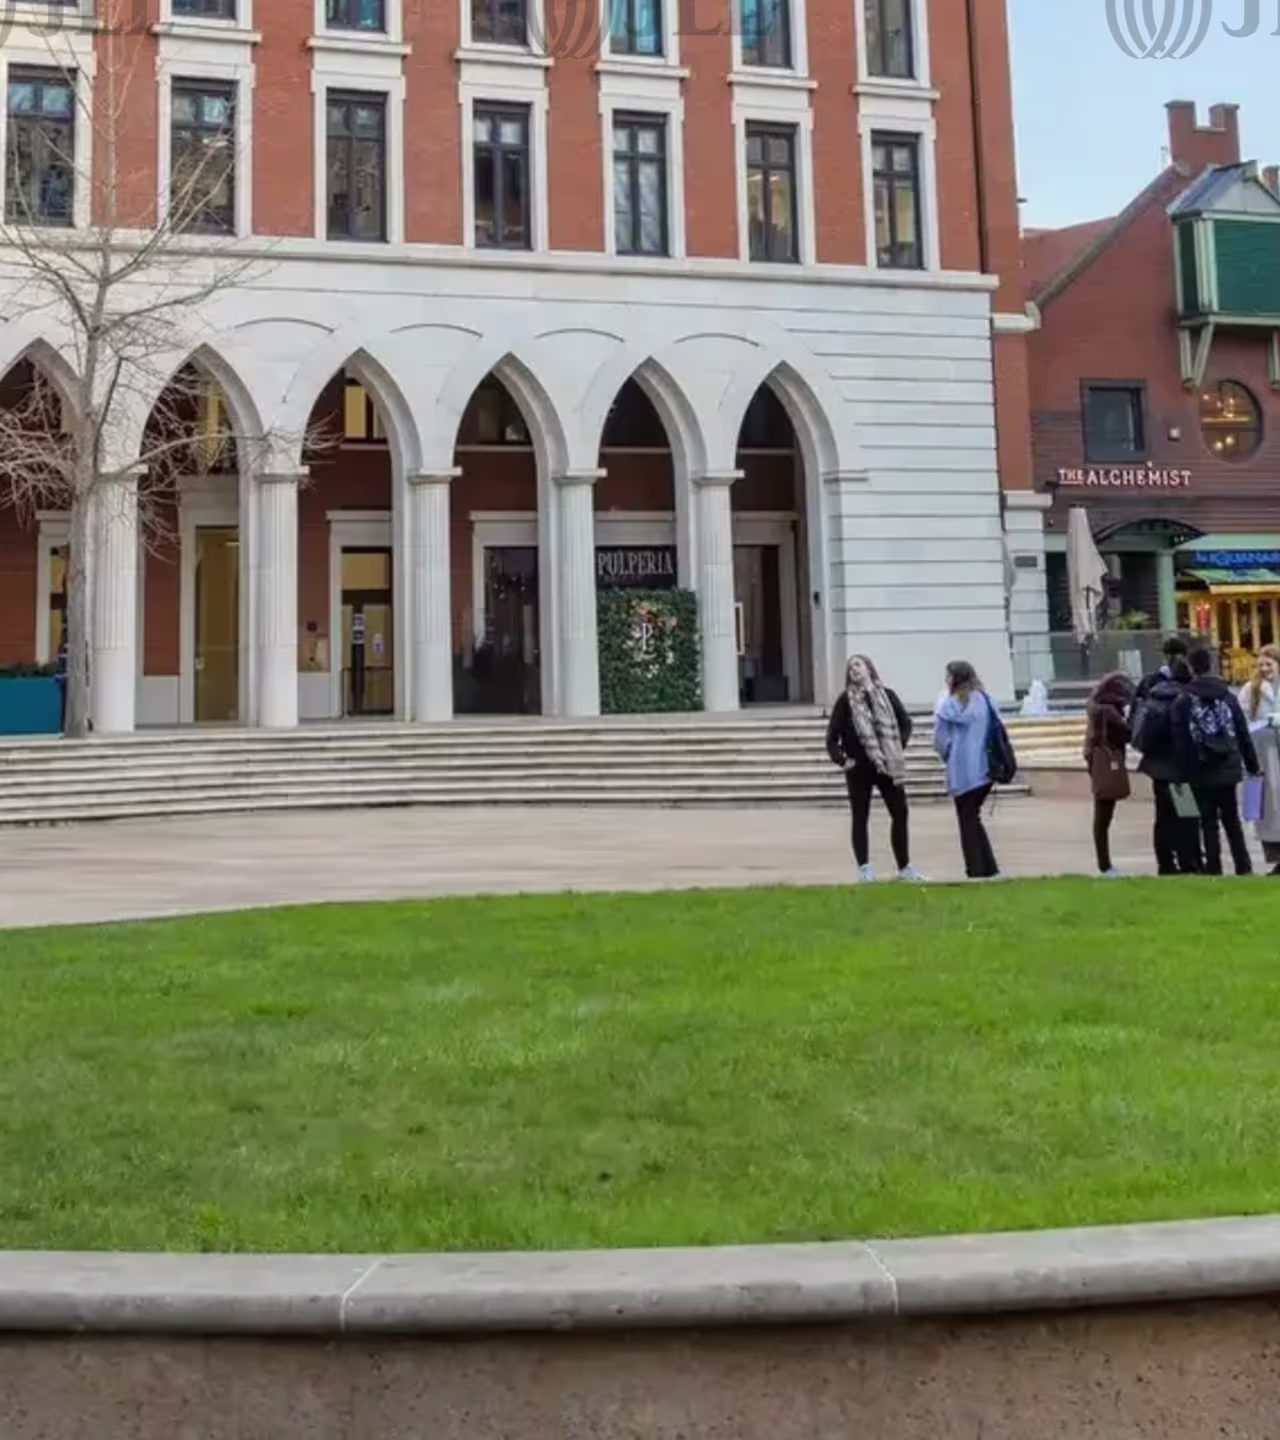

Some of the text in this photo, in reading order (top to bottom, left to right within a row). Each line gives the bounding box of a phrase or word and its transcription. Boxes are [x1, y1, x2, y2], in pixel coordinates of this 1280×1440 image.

[1058, 469, 1192, 486] THE ALCHEMIST
[597, 550, 673, 575] PULPERIA
